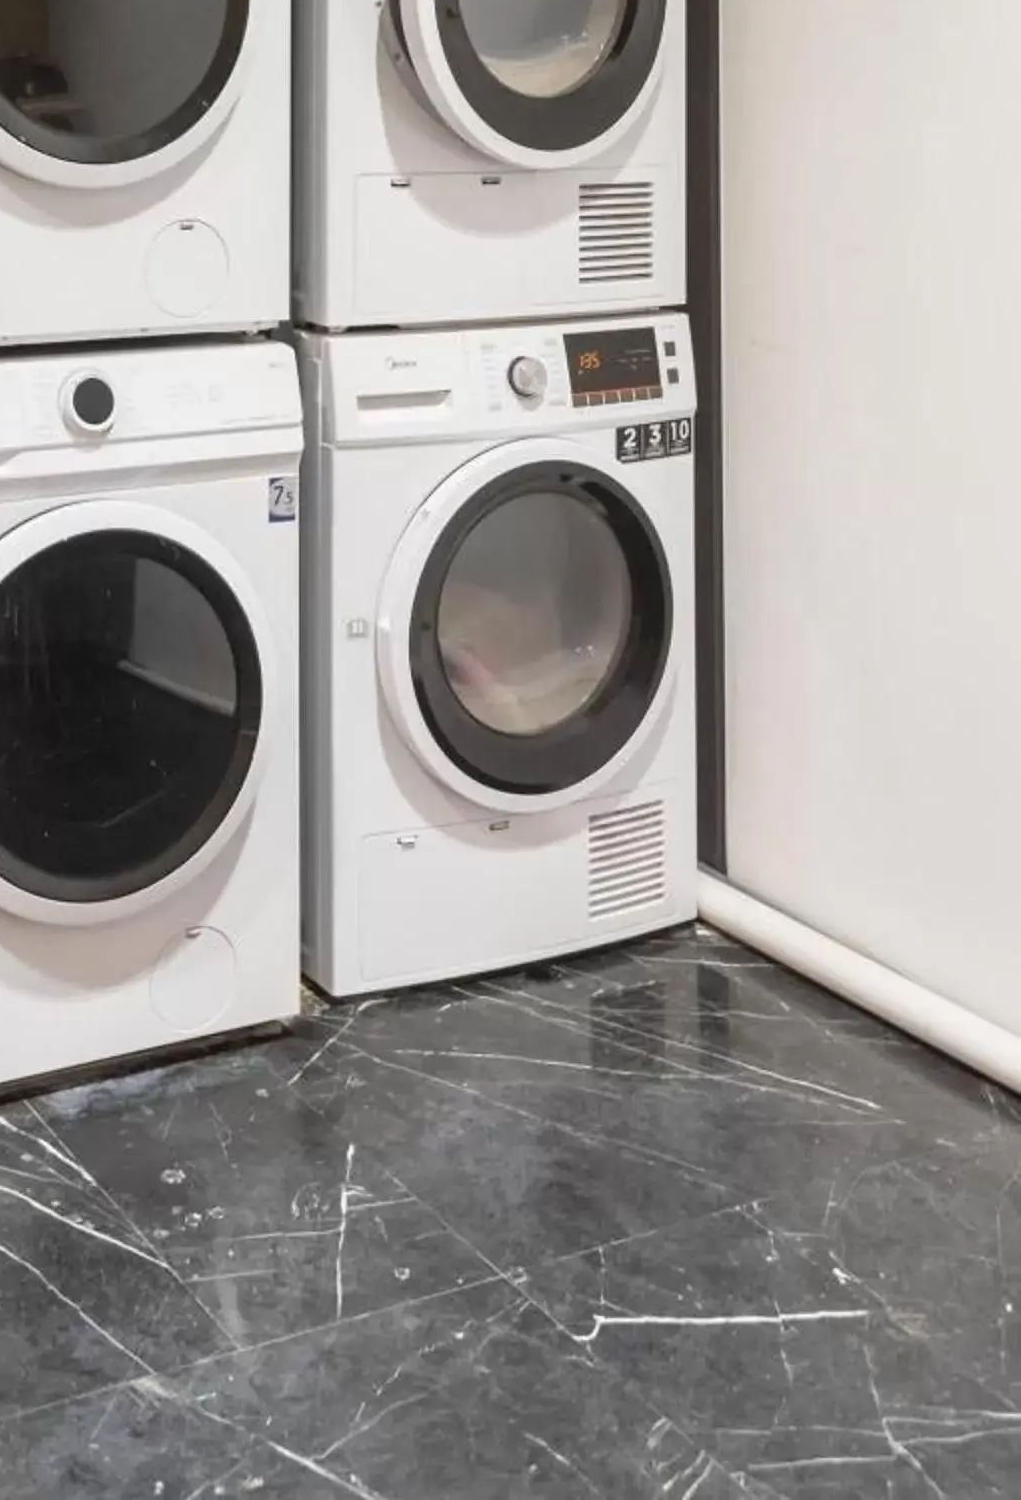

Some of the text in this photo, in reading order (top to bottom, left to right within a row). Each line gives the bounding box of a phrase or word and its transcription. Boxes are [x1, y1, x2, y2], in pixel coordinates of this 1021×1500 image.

[623, 420, 689, 448] 2 3 10
